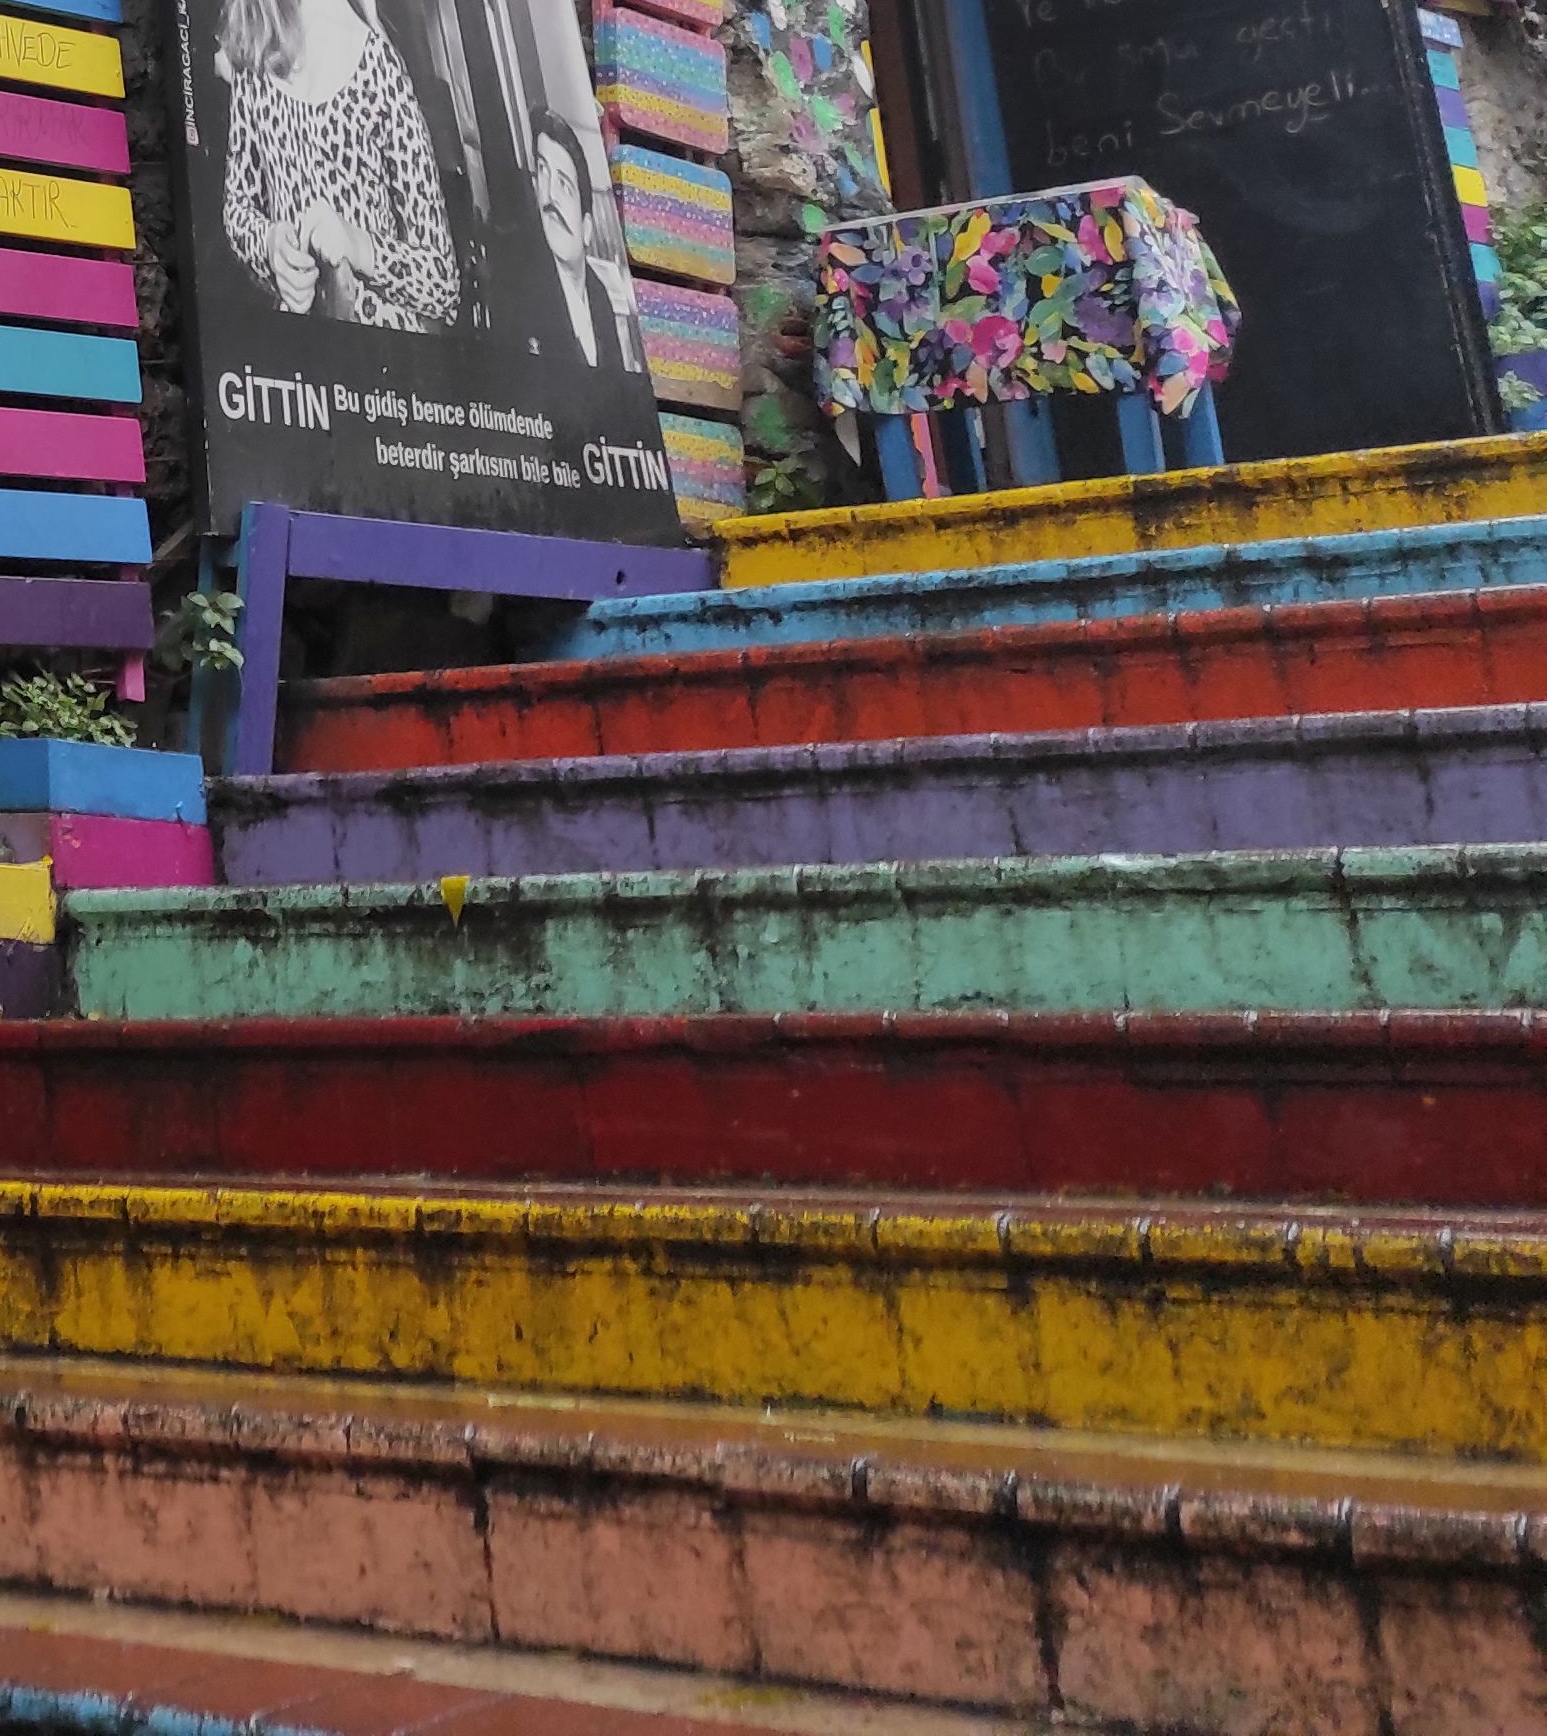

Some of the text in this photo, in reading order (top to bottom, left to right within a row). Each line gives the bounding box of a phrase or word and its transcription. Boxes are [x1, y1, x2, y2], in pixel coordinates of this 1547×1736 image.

[217, 365, 331, 432] GİTTİN
[333, 383, 360, 415] Bu
[363, 387, 409, 427] gidiş
[411, 392, 466, 427] bence
[374, 435, 445, 473] beterdir
[520, 455, 550, 486] bile
[551, 460, 582, 489] bile
[581, 435, 671, 492] GİTTİN
